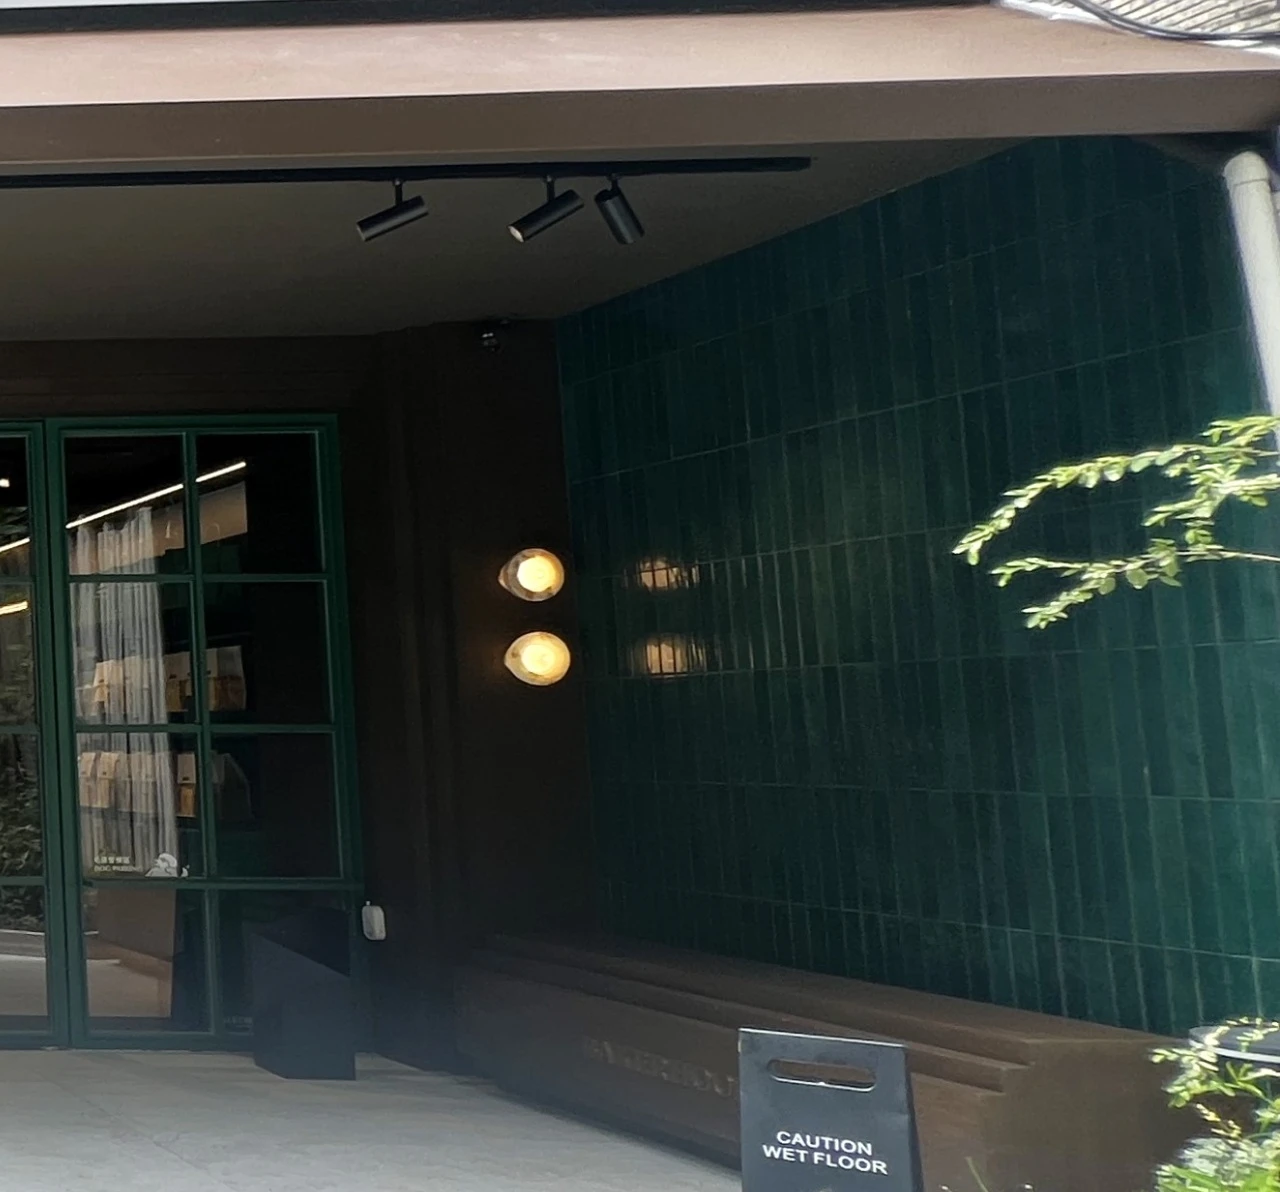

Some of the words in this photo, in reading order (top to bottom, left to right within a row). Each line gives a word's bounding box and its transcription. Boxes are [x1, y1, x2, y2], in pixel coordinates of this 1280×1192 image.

[776, 1130, 873, 1156] CAUTION
[762, 1144, 809, 1163] WET
[813, 1151, 889, 1176] FLOOR
